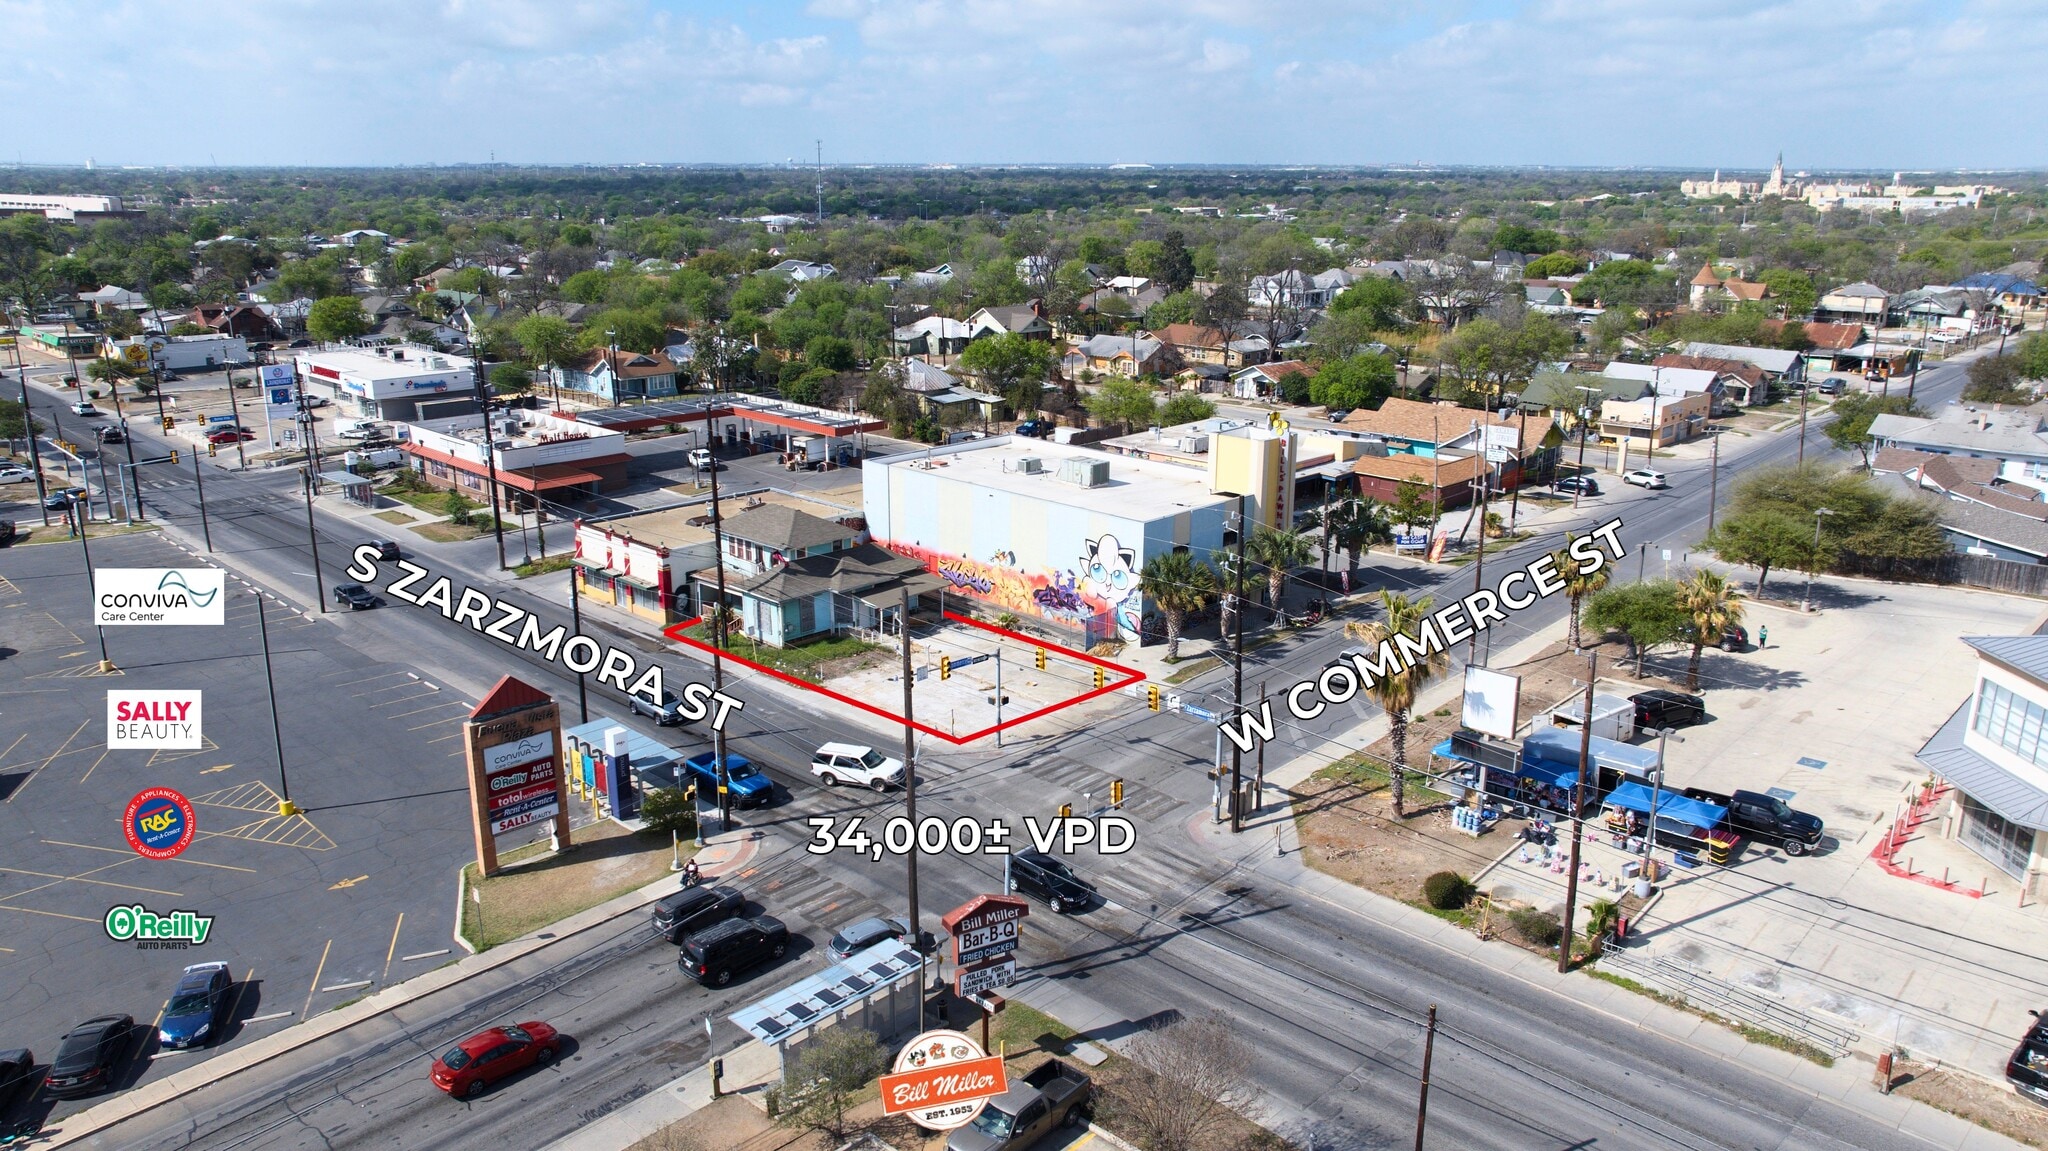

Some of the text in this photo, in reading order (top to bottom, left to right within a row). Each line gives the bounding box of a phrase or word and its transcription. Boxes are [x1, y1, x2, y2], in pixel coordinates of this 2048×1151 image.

[540, 431, 589, 442] Malt House
[478, 720, 517, 738] Buena
[502, 727, 535, 742] Plaza
[495, 759, 523, 769] Care Center
[532, 762, 551, 772] AUTO
[491, 772, 528, 790] O'Reilly
[530, 768, 554, 781] PARTS
[522, 787, 550, 800] wireless
[503, 795, 555, 817] Rent-A-Center
[499, 810, 552, 831] SALLY BEAUTY
[961, 908, 1020, 932] Bill Miller
[963, 921, 1015, 950] Bar-B-Q
[962, 941, 1015, 963] FRIED CHICKEN
[963, 969, 1011, 988] SANDWICH WITH
[966, 965, 1005, 981] PULLED PORK
[962, 985, 978, 996] FRIES
[979, 983, 984, 991] &
[985, 980, 997, 990] TEA
